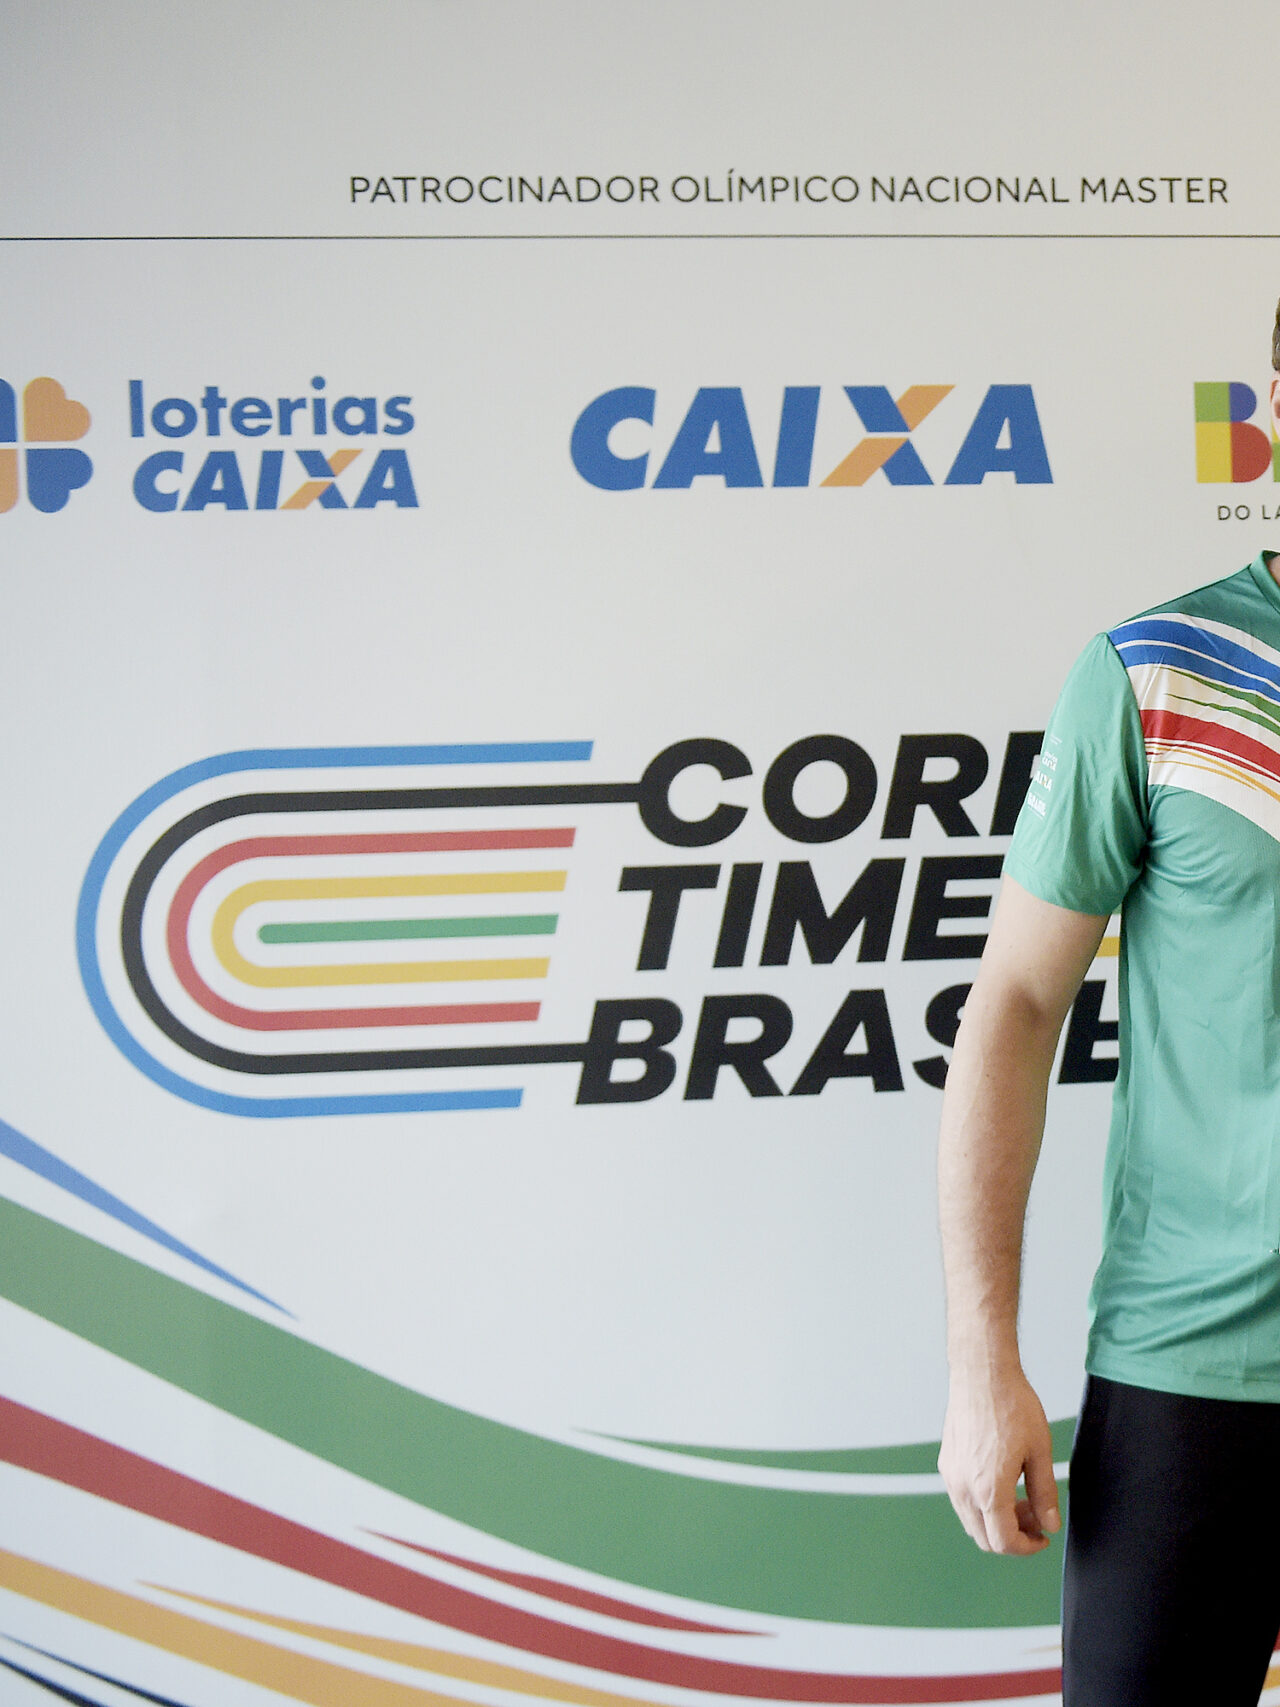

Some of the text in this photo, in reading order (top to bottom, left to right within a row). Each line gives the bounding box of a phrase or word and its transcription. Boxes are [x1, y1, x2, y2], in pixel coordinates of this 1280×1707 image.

[350, 168, 1229, 204] PATROCINADOR OLÍMPICO NACIONAL MASTER
[129, 376, 415, 438] loterias
[570, 384, 1054, 491] CAIXA
[133, 450, 420, 513] CAIXA
[1217, 504, 1250, 521] DO
[619, 854, 1004, 971] TIME
[575, 980, 1119, 1104] BRAL
